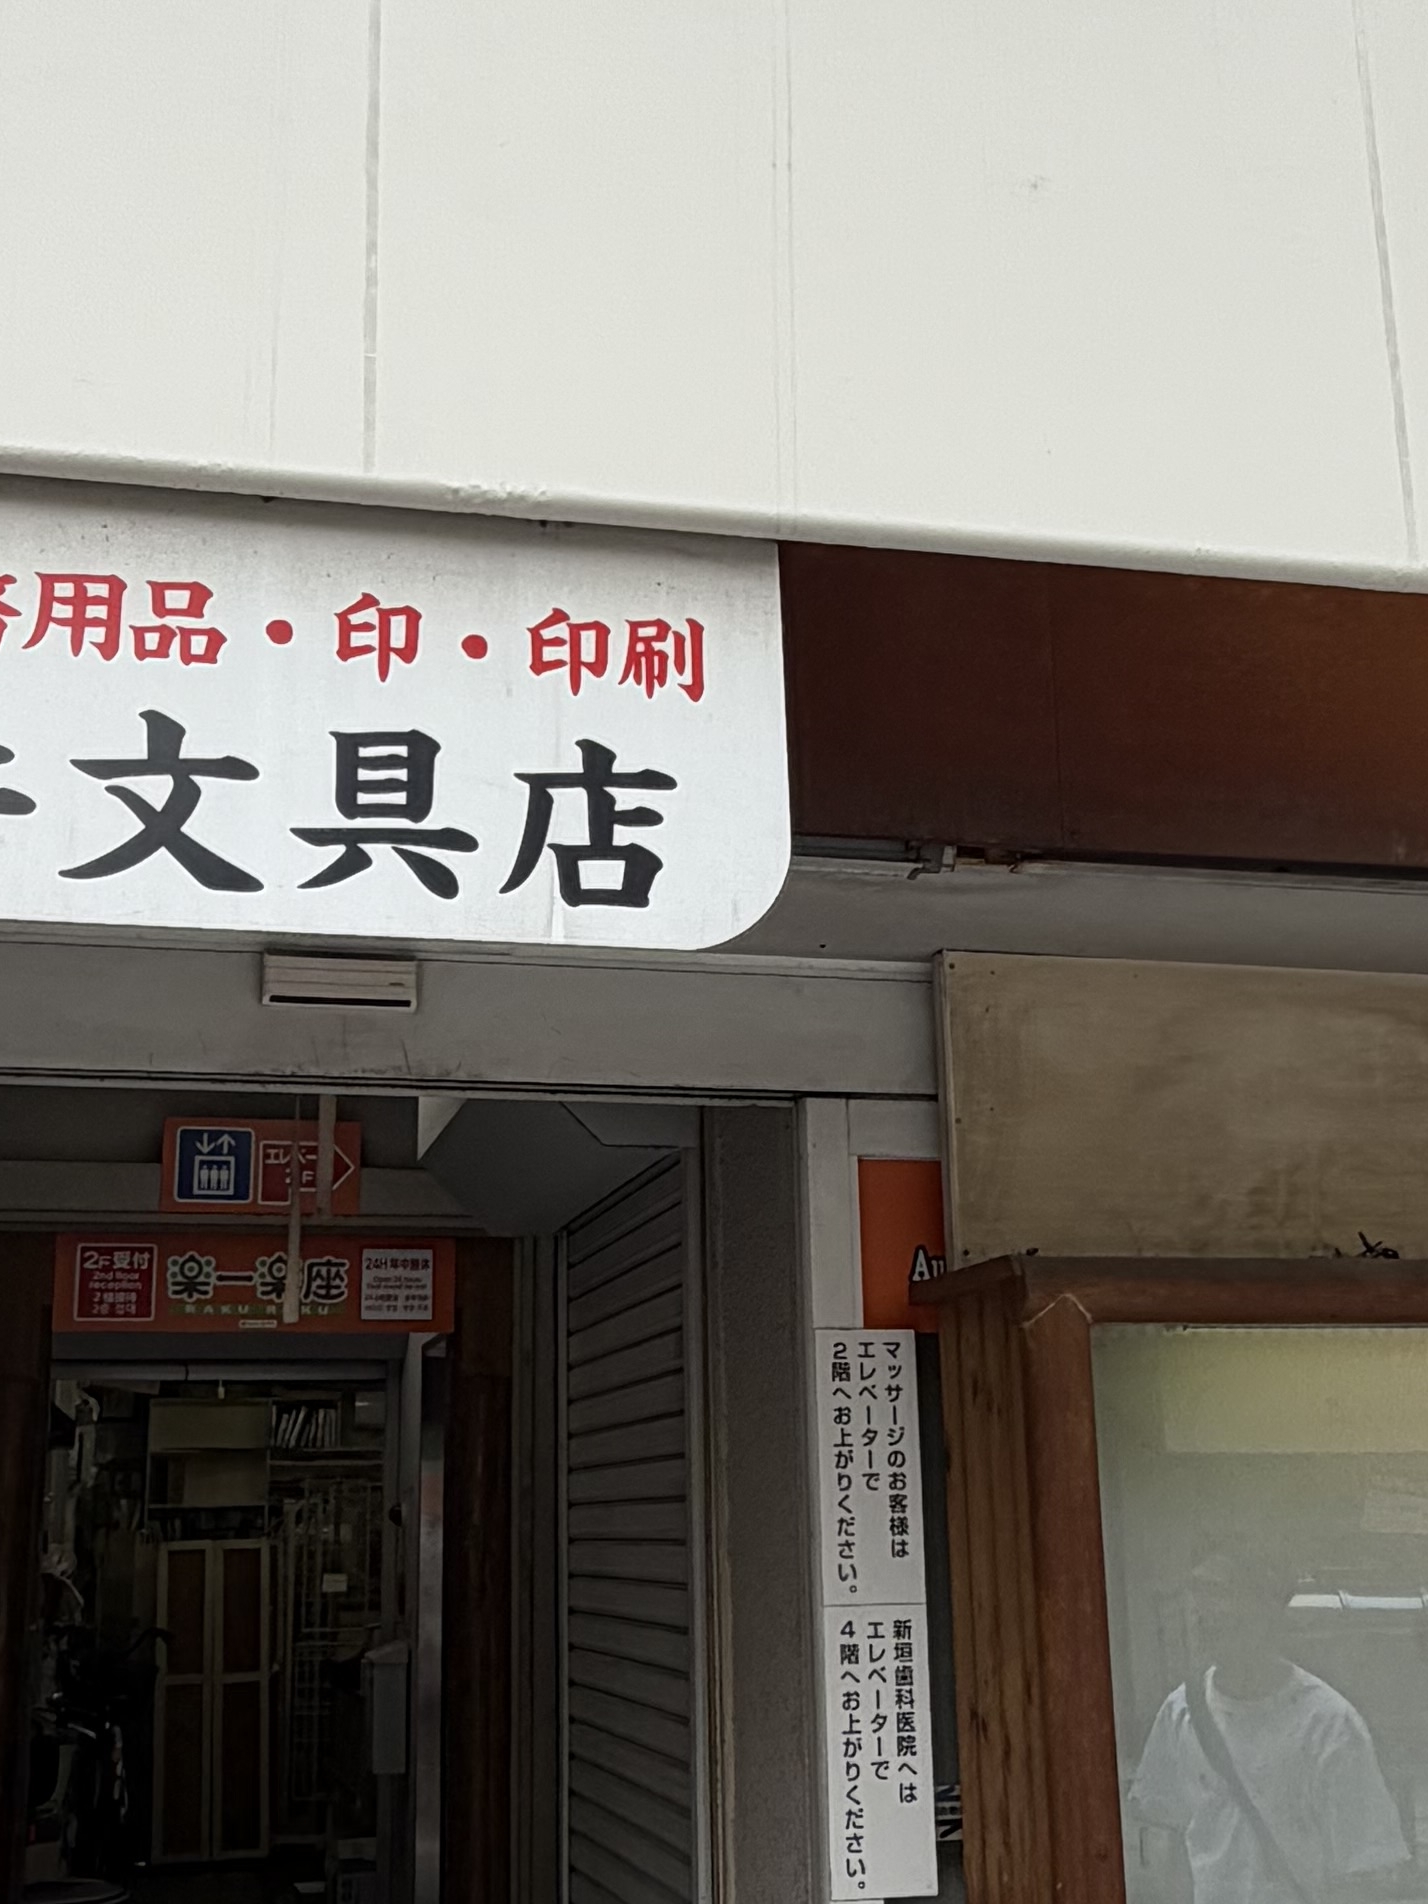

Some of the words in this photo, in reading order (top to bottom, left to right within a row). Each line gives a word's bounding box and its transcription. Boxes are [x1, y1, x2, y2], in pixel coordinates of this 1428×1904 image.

[831, 1341, 859, 1594] 2階へお上がりください。
[857, 1341, 882, 1493] エレベーターで
[882, 1340, 910, 1558] マッサージのお客様は
[839, 1620, 867, 1891] 4階へお上がりください。
[866, 1622, 891, 1781] エレベーターで
[892, 1618, 919, 1804] 新垣歯科医院へは
